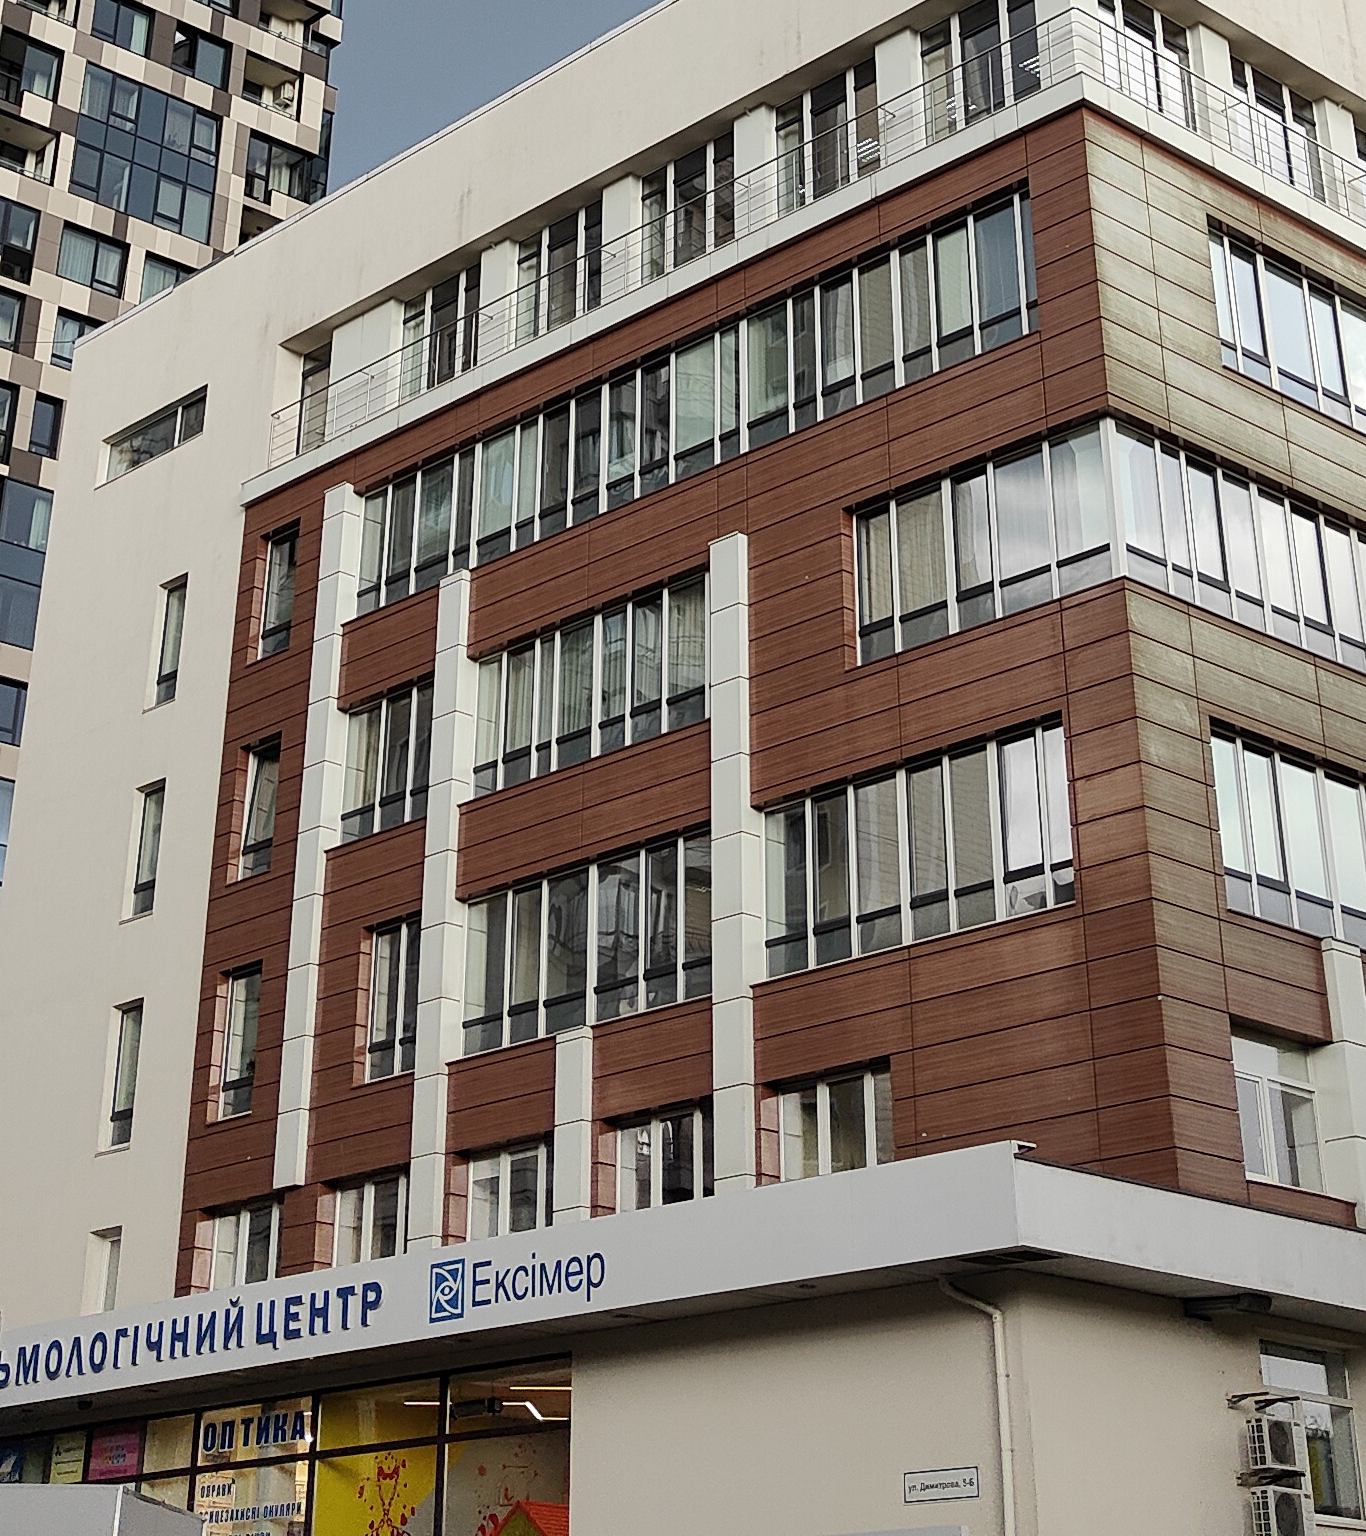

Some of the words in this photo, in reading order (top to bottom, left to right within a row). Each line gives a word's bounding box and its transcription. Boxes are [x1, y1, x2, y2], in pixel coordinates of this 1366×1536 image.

[471, 1252, 605, 1307] Ексімер
[255, 1281, 383, 1350] ЦЕНТР
[202, 1410, 306, 1453] ОПТИКА
[200, 1483, 232, 1499] ОПРАВИ
[263, 1502, 302, 1519] ОКУЛЯРИ
